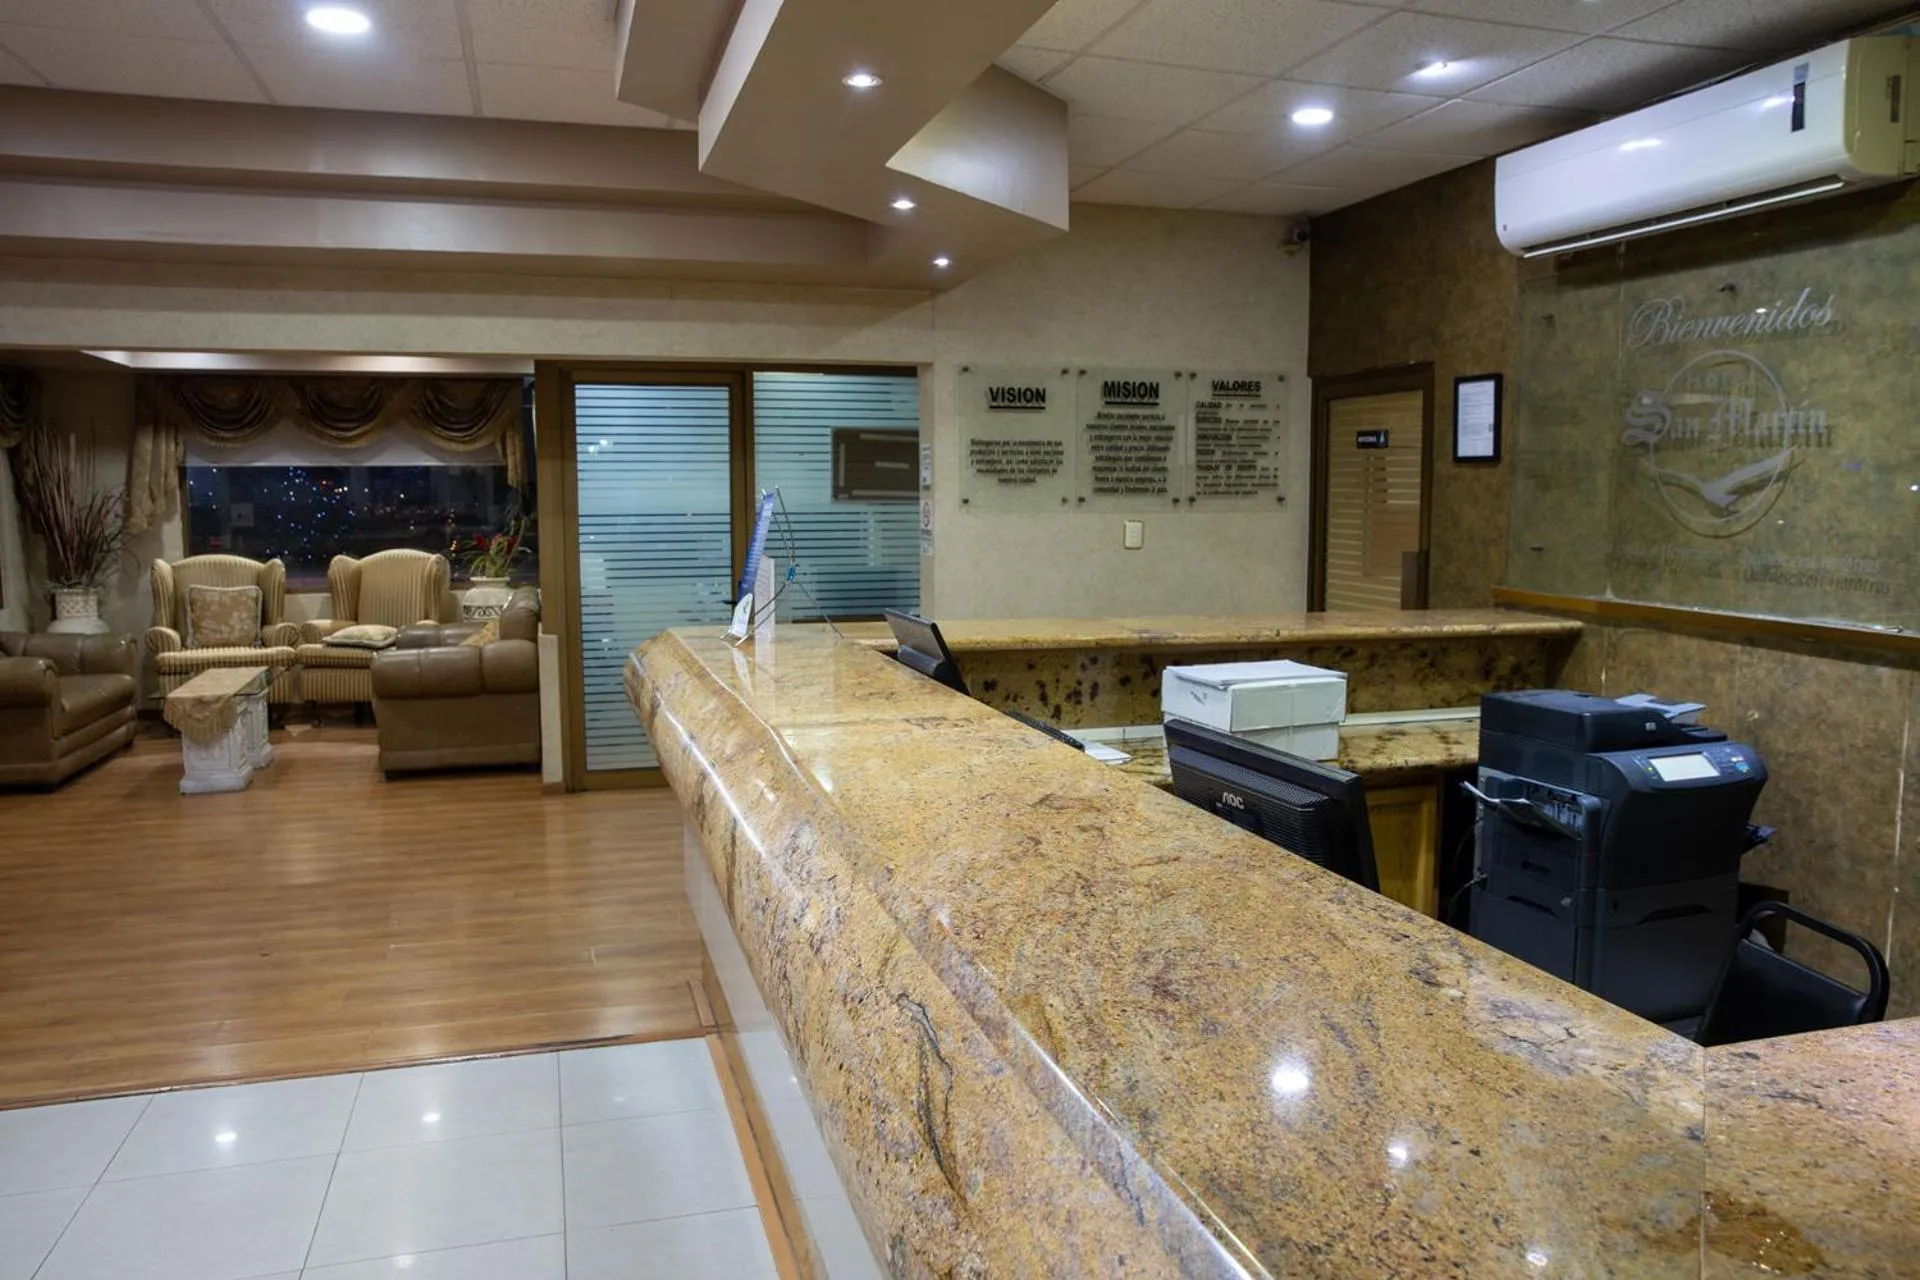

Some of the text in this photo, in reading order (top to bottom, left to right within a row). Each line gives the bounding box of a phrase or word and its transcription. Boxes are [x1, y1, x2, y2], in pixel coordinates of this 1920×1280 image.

[1627, 287, 1835, 348] Bienvenidos
[988, 387, 1046, 403] VISION
[1103, 381, 1160, 399] MISION
[1211, 380, 1262, 392] VALORES
[1621, 390, 1828, 446] San Martín
[1222, 792, 1244, 810] AOC
